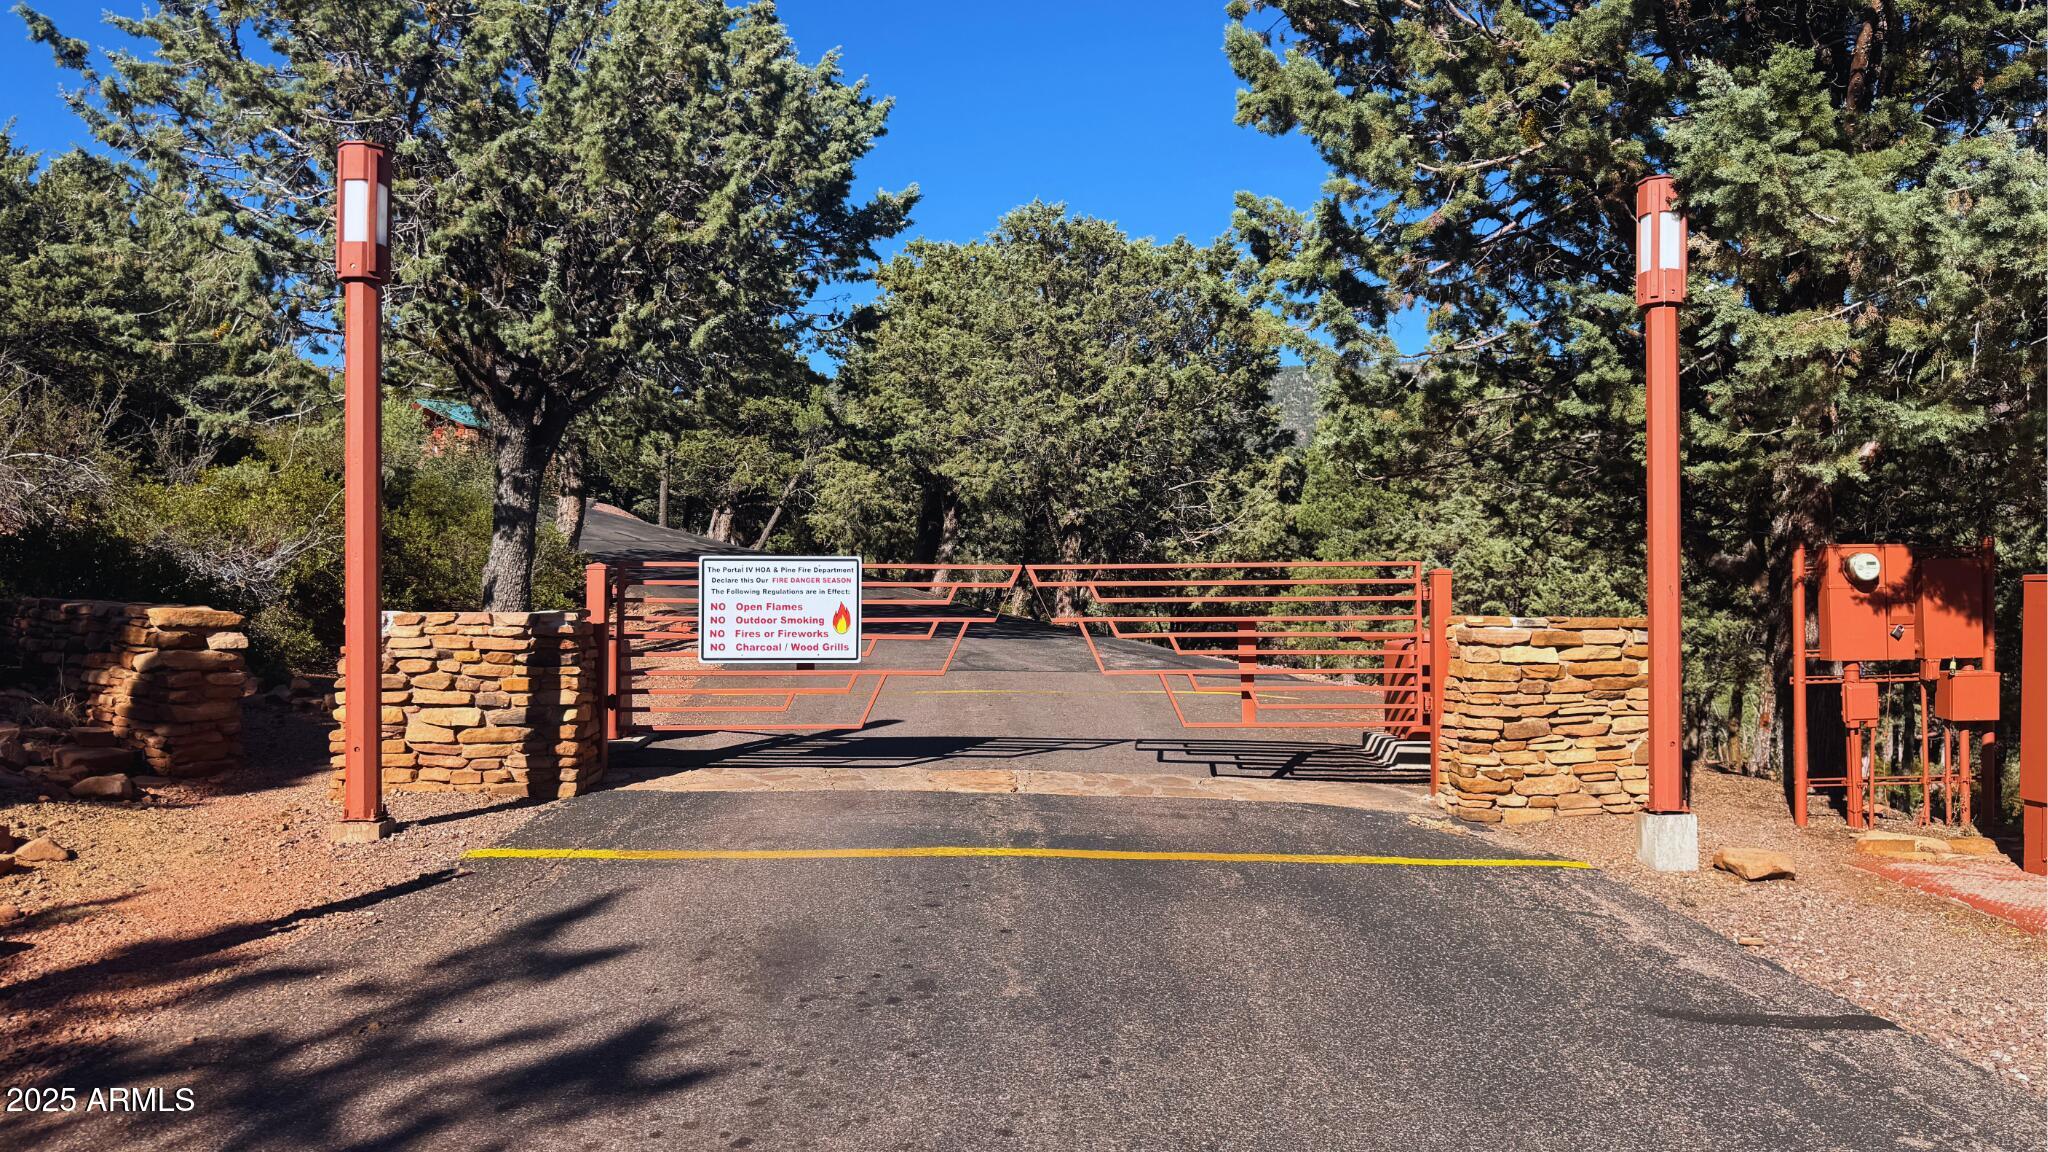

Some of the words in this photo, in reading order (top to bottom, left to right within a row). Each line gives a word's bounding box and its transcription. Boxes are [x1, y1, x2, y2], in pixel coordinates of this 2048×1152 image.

[711, 603, 726, 611] NO
[736, 603, 762, 612] Open
[766, 603, 803, 611] Flames
[736, 616, 777, 624] Outdoor
[780, 616, 824, 626] Smoking
[736, 643, 782, 651] Charcoal
[791, 643, 819, 651] Wood
[822, 643, 849, 651] Grills
